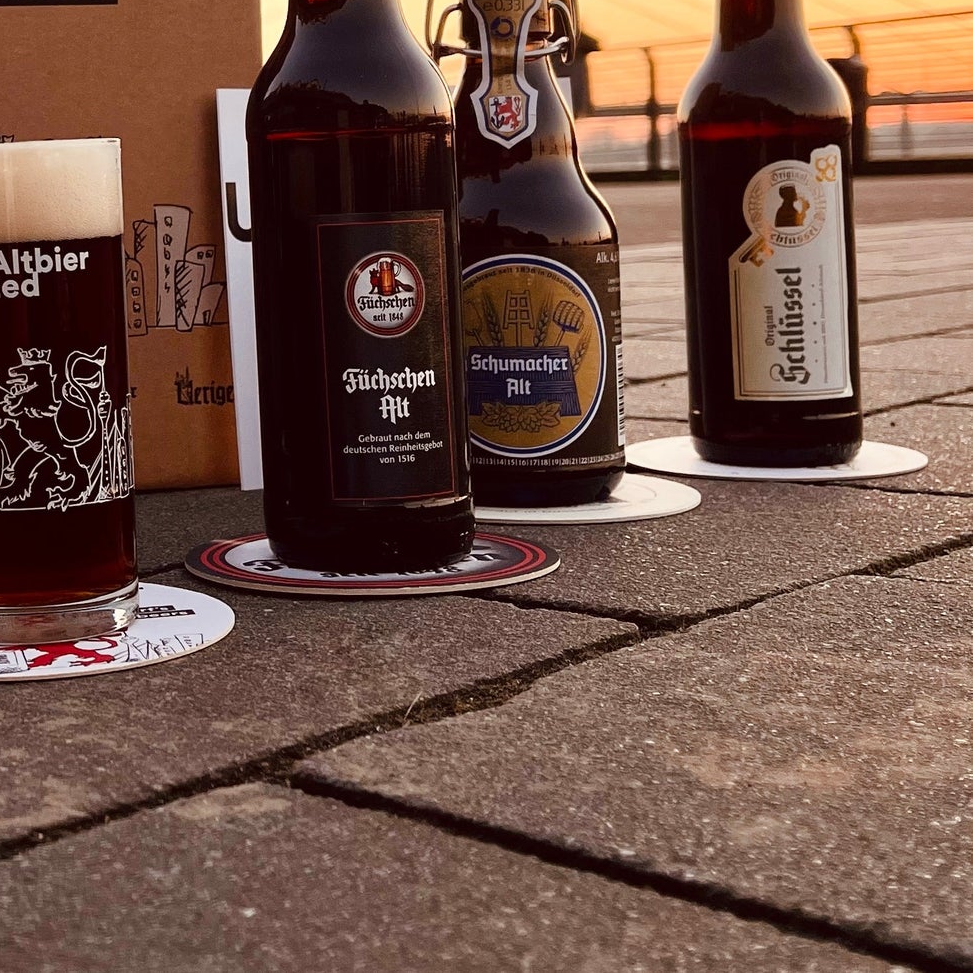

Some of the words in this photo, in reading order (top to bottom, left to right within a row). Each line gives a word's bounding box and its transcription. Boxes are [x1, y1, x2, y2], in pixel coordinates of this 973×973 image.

[357, 295, 415, 312] Füchschen
[373, 314, 387, 322] seit
[389, 312, 404, 322] 1848
[764, 305, 776, 346] Original
[770, 267, 811, 384] Schlüssel
[471, 354, 569, 375] Schumacher
[342, 367, 436, 394] Füchschen
[506, 378, 532, 398] Alt
[379, 394, 410, 424] Alt
[358, 432, 393, 443] Gebraut
[394, 432, 413, 442] nach
[414, 430, 431, 440] dem
[343, 444, 388, 454] deutschen
[389, 440, 443, 453] Reinheitsgebot
[379, 455, 395, 464] von
[398, 454, 416, 463] 1516
